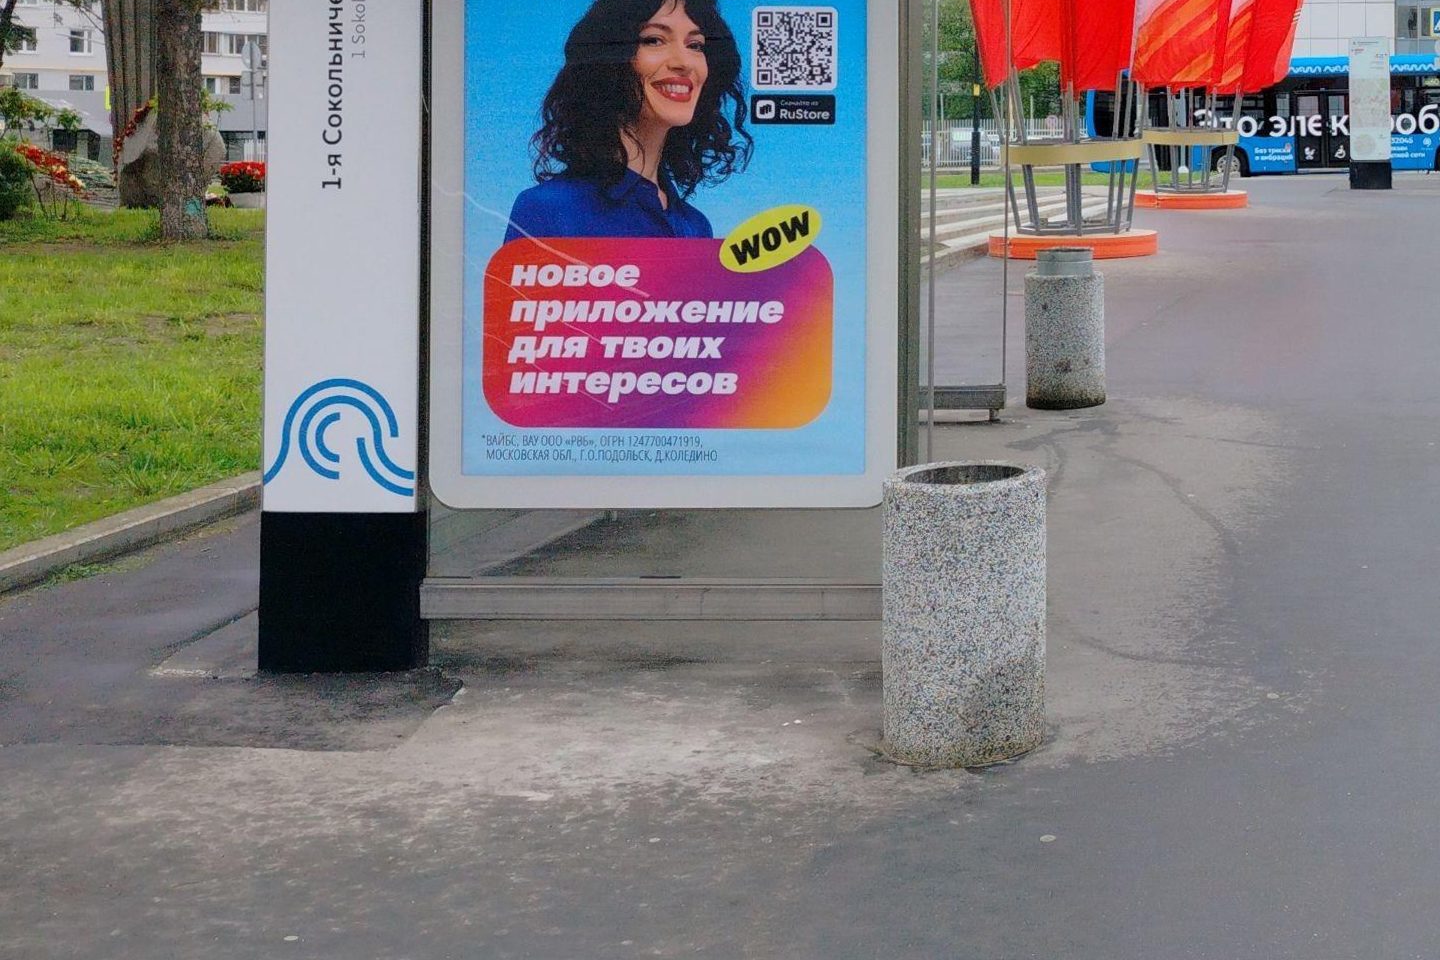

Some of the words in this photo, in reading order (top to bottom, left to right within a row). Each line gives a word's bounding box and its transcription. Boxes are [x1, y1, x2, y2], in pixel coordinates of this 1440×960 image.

[780, 108, 830, 119] RuStore
[322, 154, 342, 189] 1-я
[730, 211, 811, 266] WOW
[511, 264, 640, 287] новое
[509, 300, 785, 331] приложение
[507, 336, 589, 363] для
[600, 337, 726, 359] твоих
[509, 371, 738, 403] интересов
[522, 435, 539, 446] ВАУ
[541, 435, 563, 447] ООО
[600, 435, 624, 447] ОГРН
[486, 449, 549, 461] МОСКОВСКАЯ
